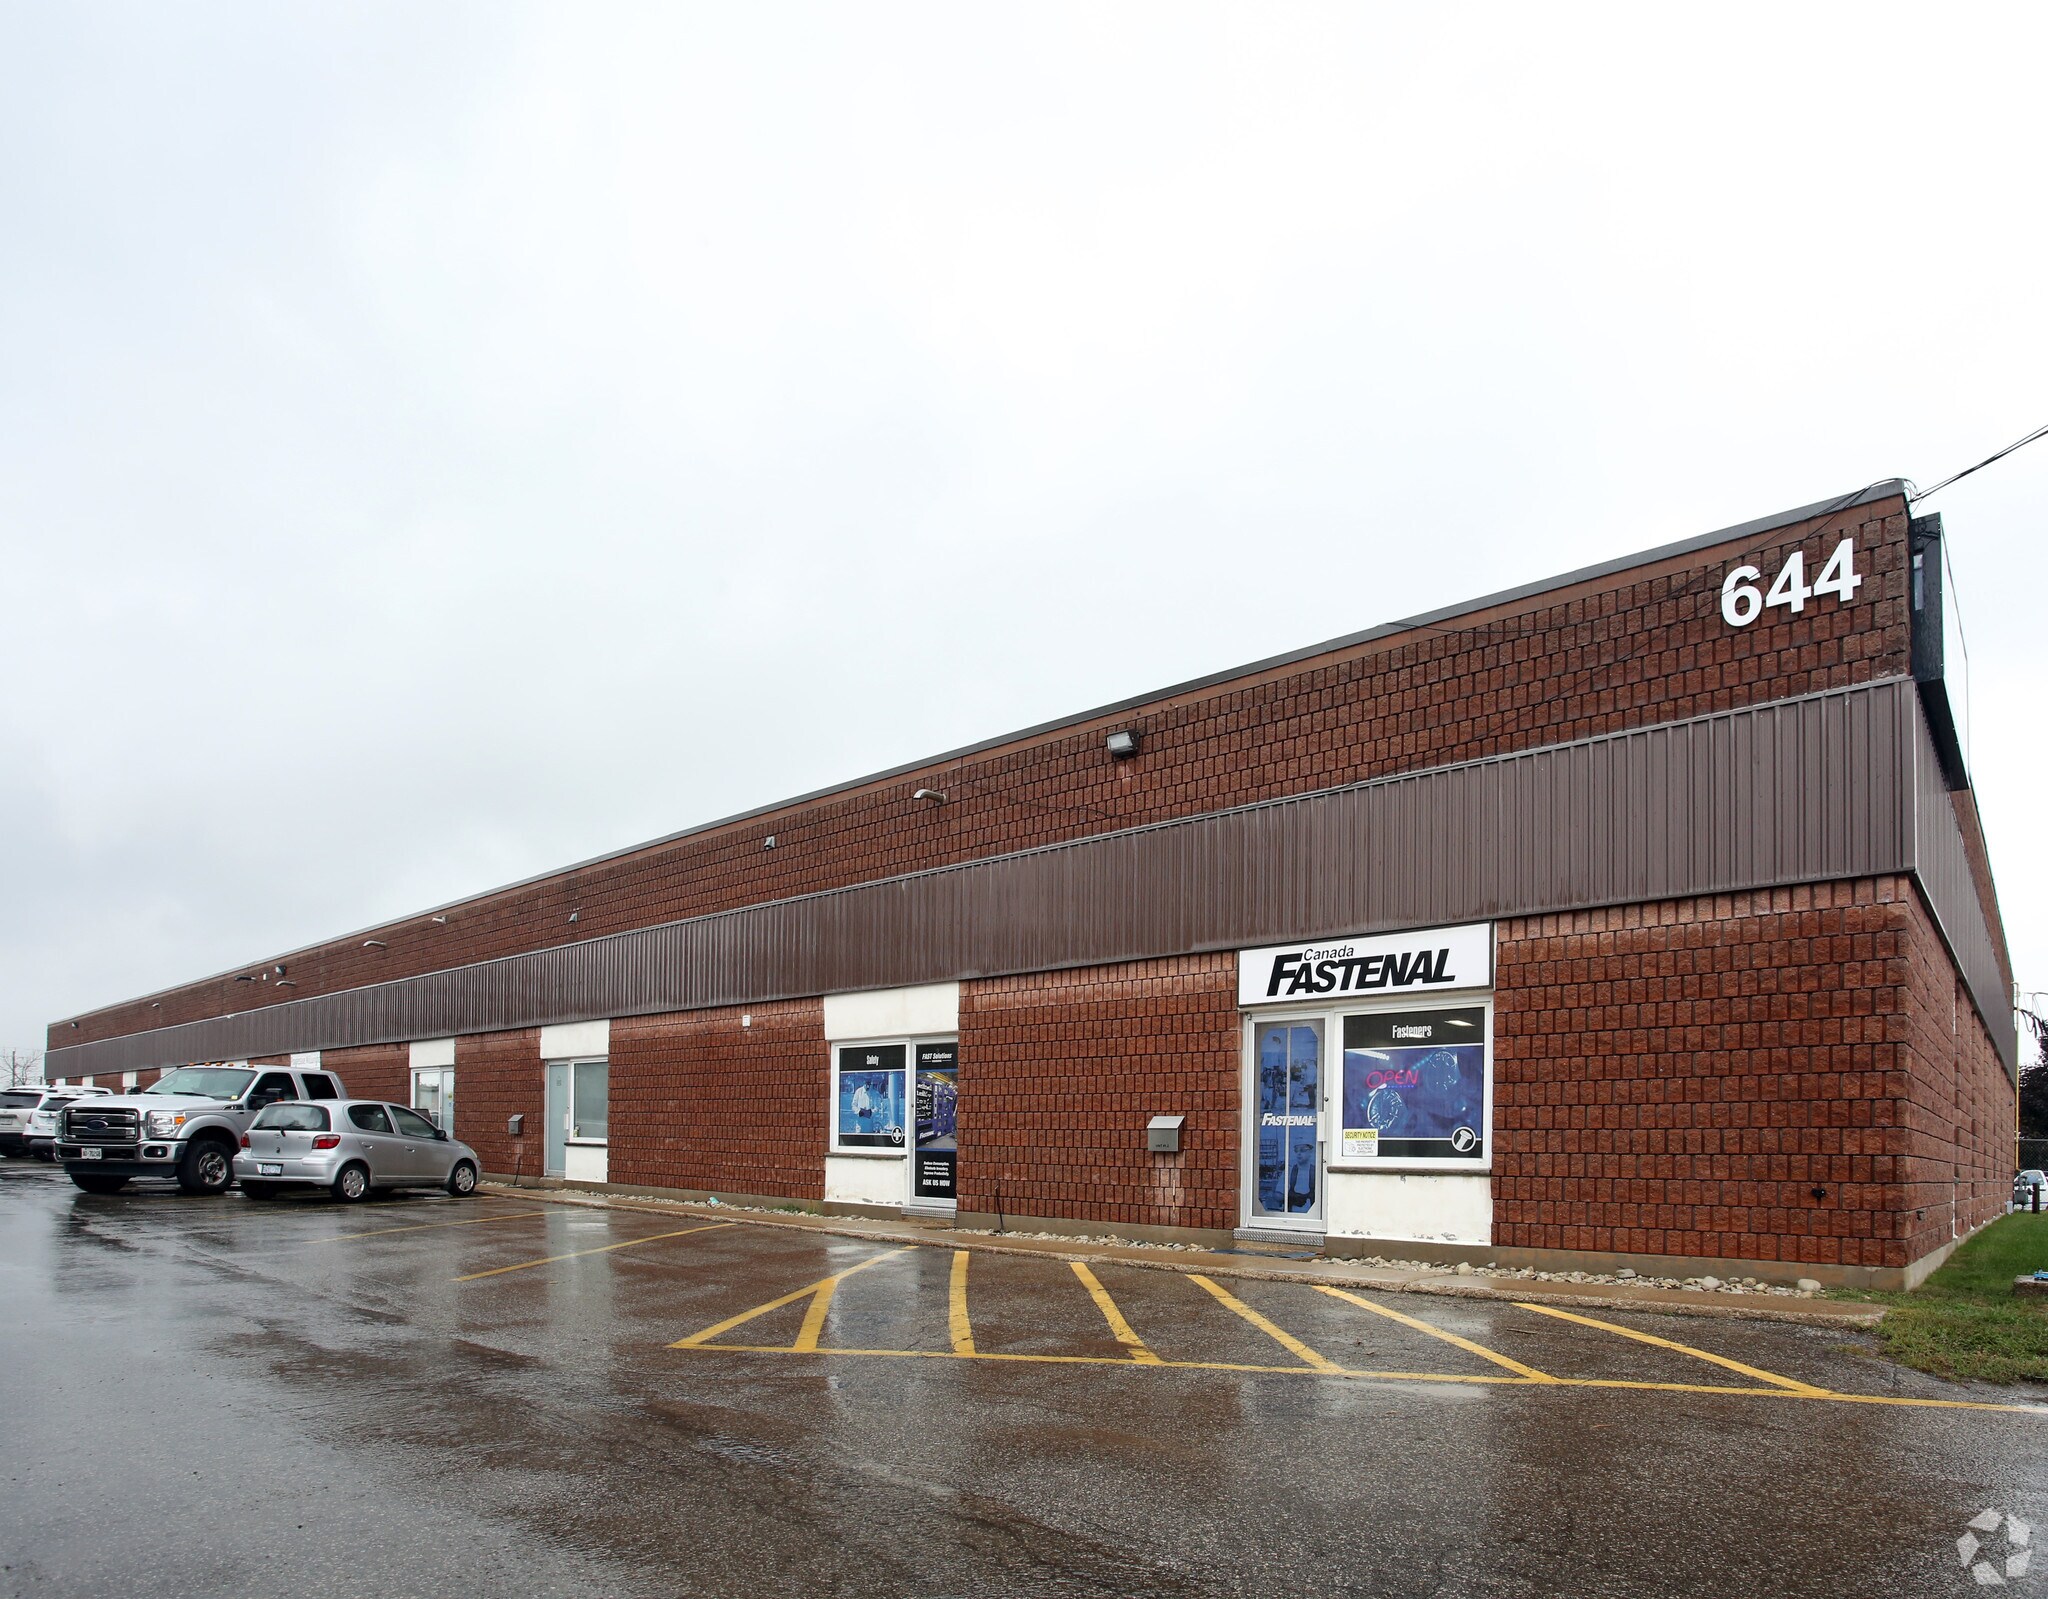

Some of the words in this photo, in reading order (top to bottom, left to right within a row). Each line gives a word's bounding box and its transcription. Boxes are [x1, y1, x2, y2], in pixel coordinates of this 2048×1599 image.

[1721, 538, 1862, 627] 644
[1303, 944, 1355, 961] Canada
[1266, 948, 1456, 997] FASTENAL
[1392, 1024, 1432, 1039] Fasteners
[1366, 1069, 1419, 1089] OPEN
[1261, 1112, 1314, 1126] FASTENAL
[1345, 1131, 1362, 1139] SECURITY
[1362, 1131, 1376, 1139] NOTICE
[922, 1178, 932, 1186] ASK
[939, 1179, 951, 1187] NOW
